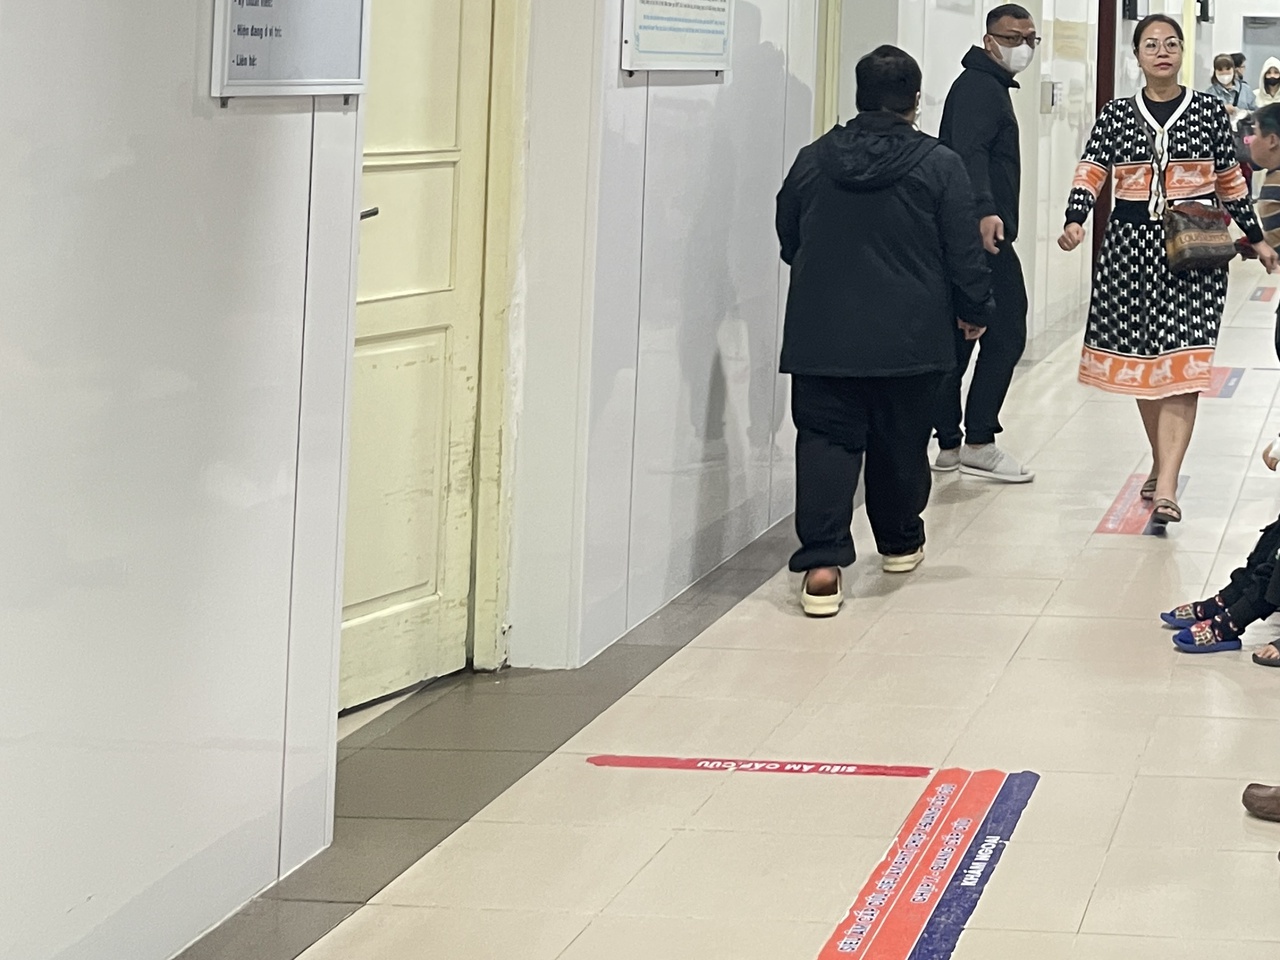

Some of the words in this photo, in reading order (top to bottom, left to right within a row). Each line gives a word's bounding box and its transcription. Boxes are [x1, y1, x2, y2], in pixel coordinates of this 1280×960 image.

[784, 763, 816, 773] ÂM
[818, 764, 858, 774] SIÊU
[960, 862, 987, 886] KHÁM
